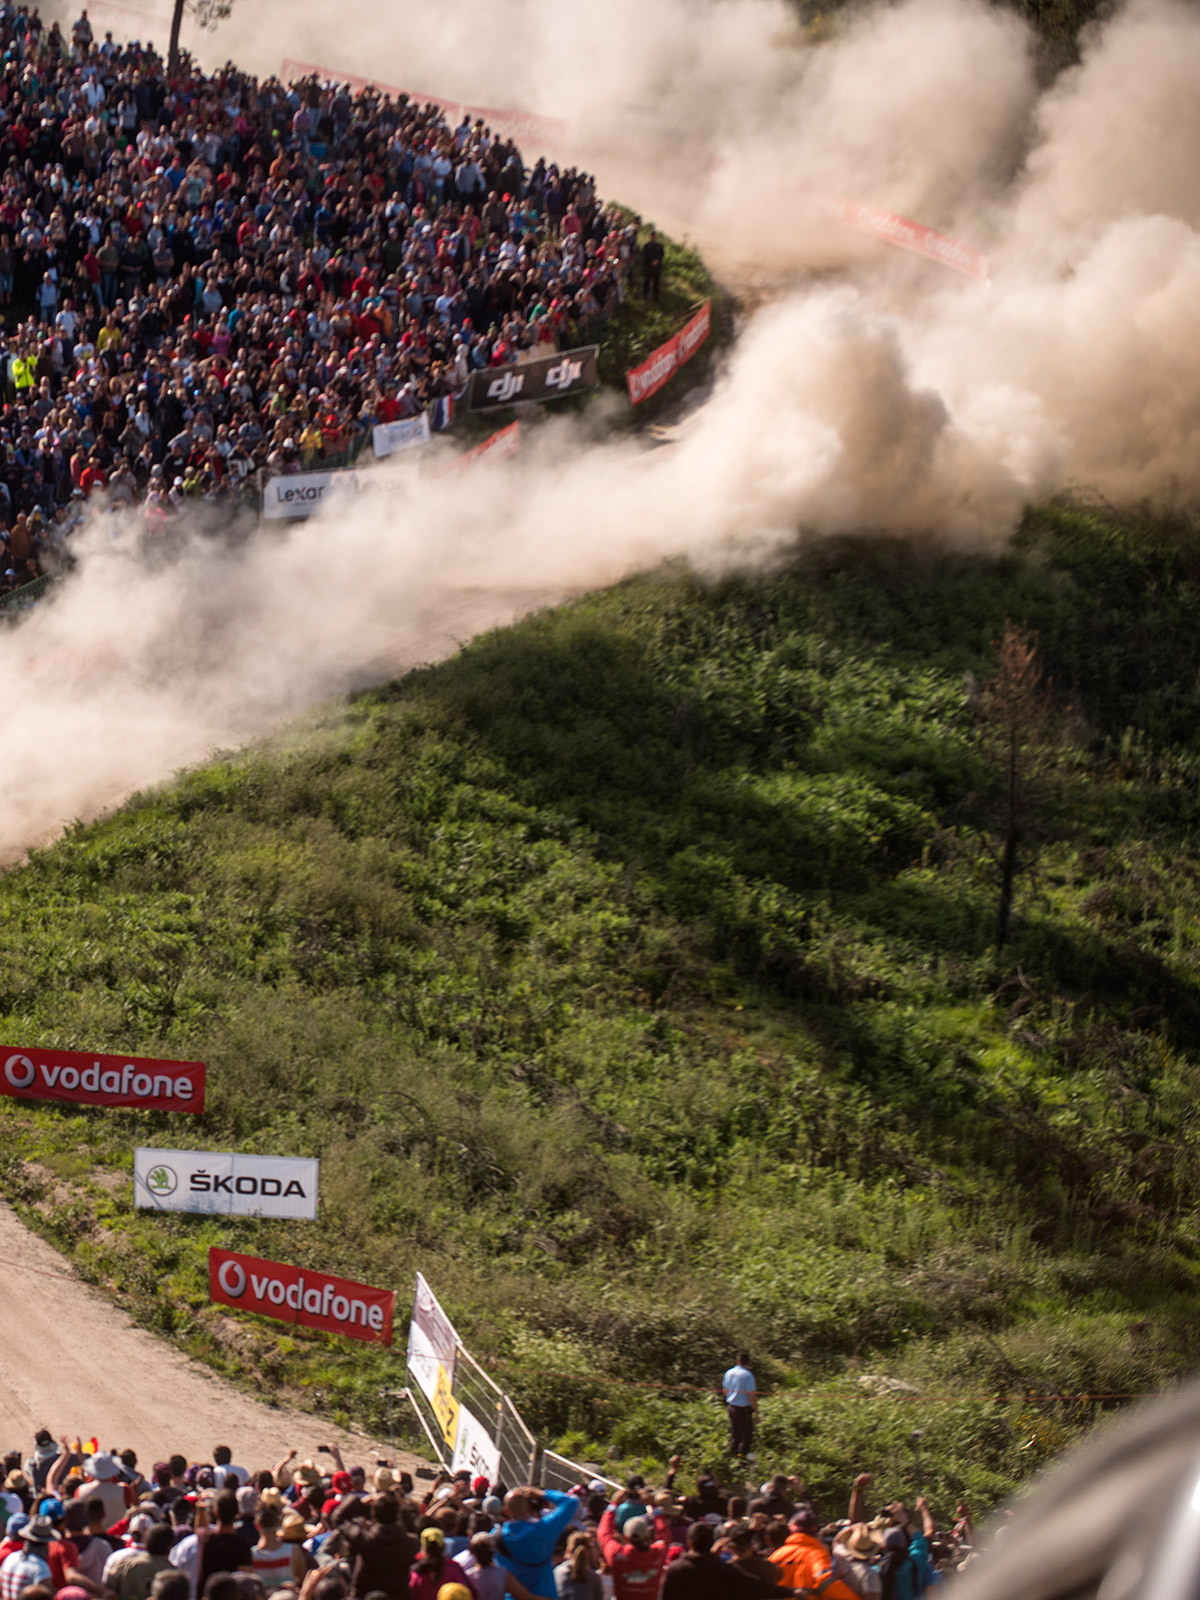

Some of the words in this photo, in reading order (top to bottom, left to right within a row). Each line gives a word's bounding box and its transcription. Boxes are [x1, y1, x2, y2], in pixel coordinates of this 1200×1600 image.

[276, 485, 325, 503] Lexar
[40, 1062, 194, 1100] vodafone
[189, 1169, 306, 1198] ŠKODA
[250, 1274, 384, 1330] vodafone
